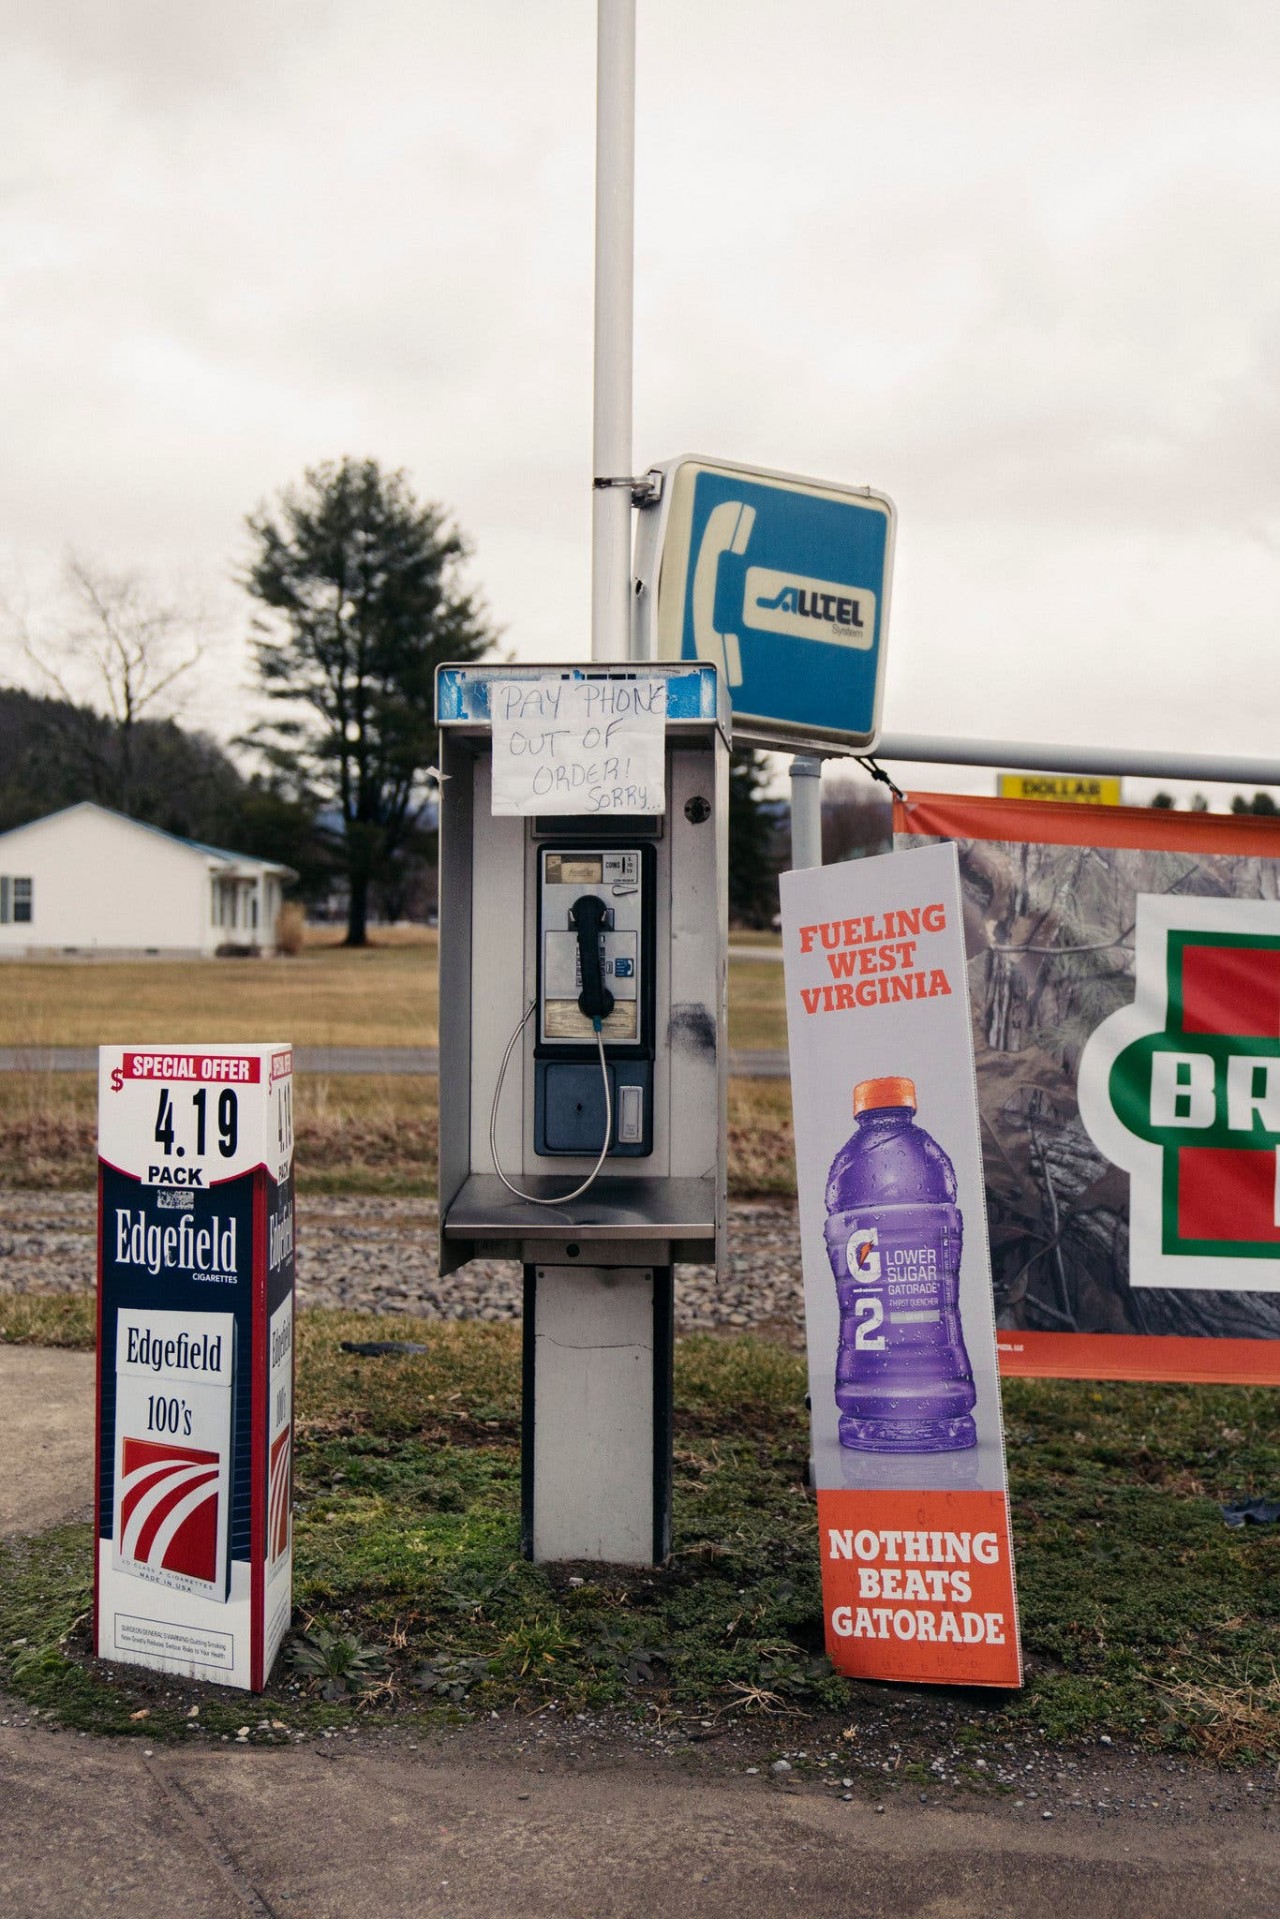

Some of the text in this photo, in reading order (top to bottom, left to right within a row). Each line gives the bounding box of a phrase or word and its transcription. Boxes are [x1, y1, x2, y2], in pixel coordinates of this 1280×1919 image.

[756, 586, 864, 628] ALLTEL
[832, 624, 863, 638] System
[500, 683, 664, 720] PAY PHONE
[510, 718, 624, 758] OUT OF
[532, 758, 630, 796] ORDER!
[799, 904, 946, 953] FUELING
[827, 941, 916, 979] WEST
[800, 968, 952, 1014] VIRGINIA
[132, 1056, 196, 1078] SPECIAL
[202, 1058, 250, 1080] OFFER
[111, 1067, 238, 1158] $ 4.19
[148, 1166, 202, 1186] PACK
[114, 1209, 238, 1274] Edgefield
[846, 1228, 882, 1283] G
[886, 1250, 936, 1266] LOWER
[192, 1272, 238, 1284] CIGARETTES
[887, 1266, 936, 1282] SUGAR
[888, 1283, 938, 1295] GATORADE
[855, 1298, 886, 1350] 2
[126, 1327, 222, 1372] Edgefield
[147, 1395, 192, 1436] 100's
[828, 1529, 999, 1564] NOTHING
[134, 1563, 155, 1573] CLASS
[166, 1573, 214, 1591] CIGARETTES
[139, 1572, 160, 1582] MADE
[176, 1584, 192, 1593] USA
[858, 1568, 972, 1602] BEATS
[832, 1606, 1005, 1644] GATORADE
[208, 1640, 226, 1651] Smoking
